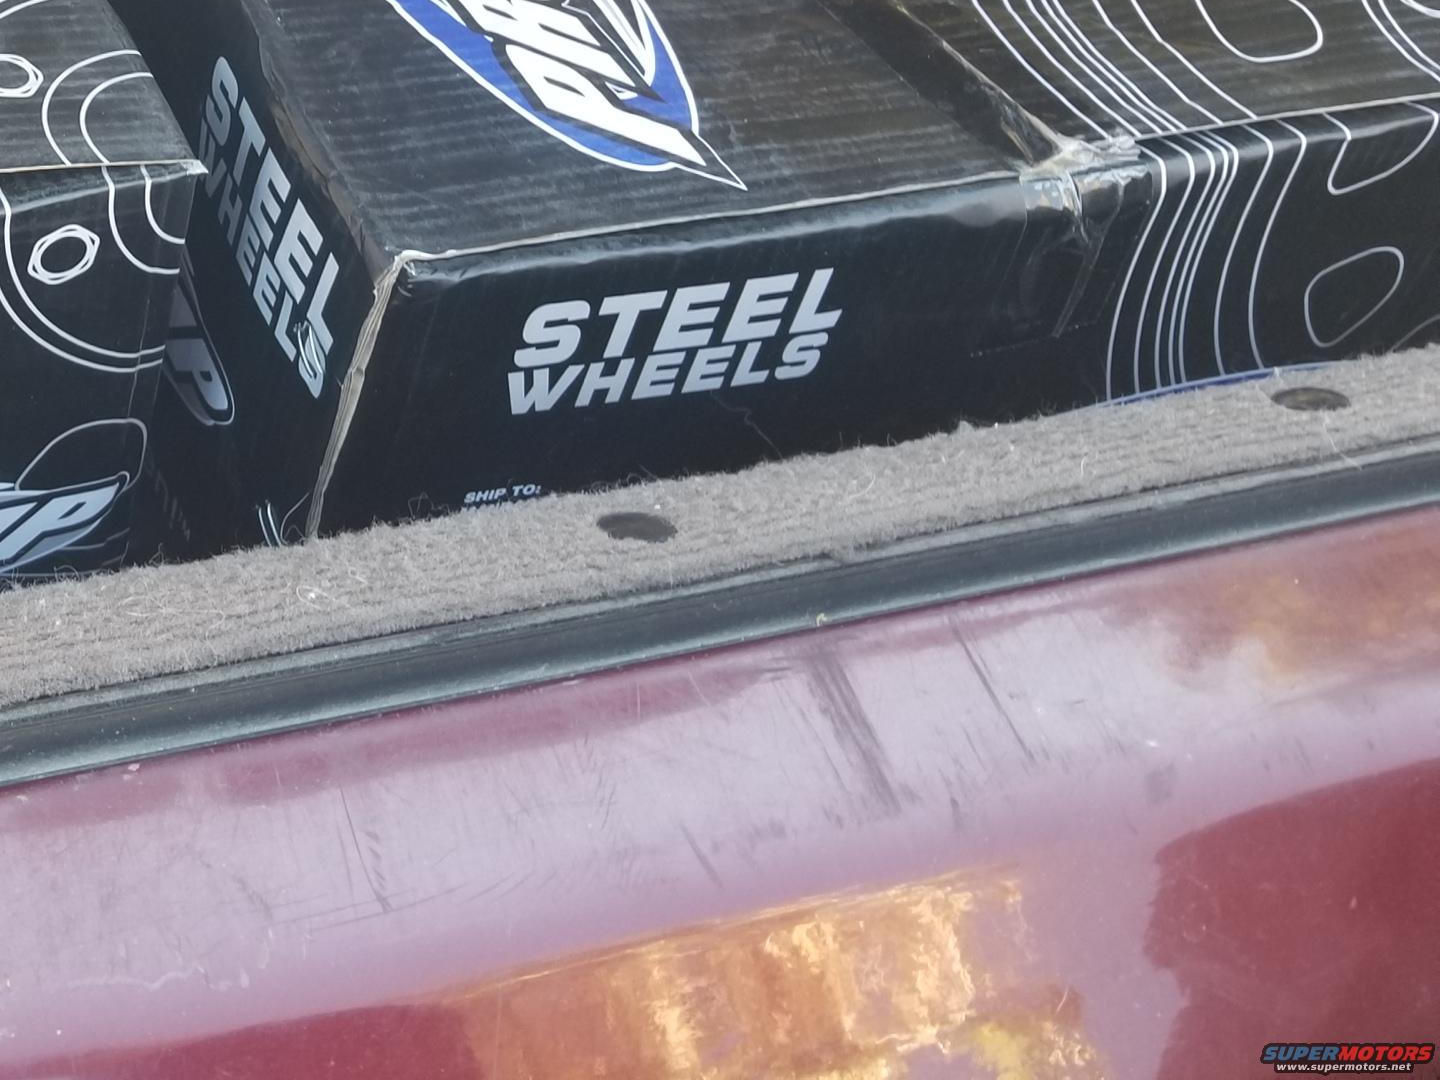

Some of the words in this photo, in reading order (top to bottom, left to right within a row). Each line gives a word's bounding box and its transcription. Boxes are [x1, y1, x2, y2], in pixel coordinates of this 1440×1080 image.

[198, 104, 326, 399] WHEELS
[205, 56, 339, 357] STEEL
[513, 266, 843, 369] STEEL
[507, 330, 829, 415] WHEELS
[463, 487, 507, 504] SHIP
[512, 483, 542, 497] TO:
